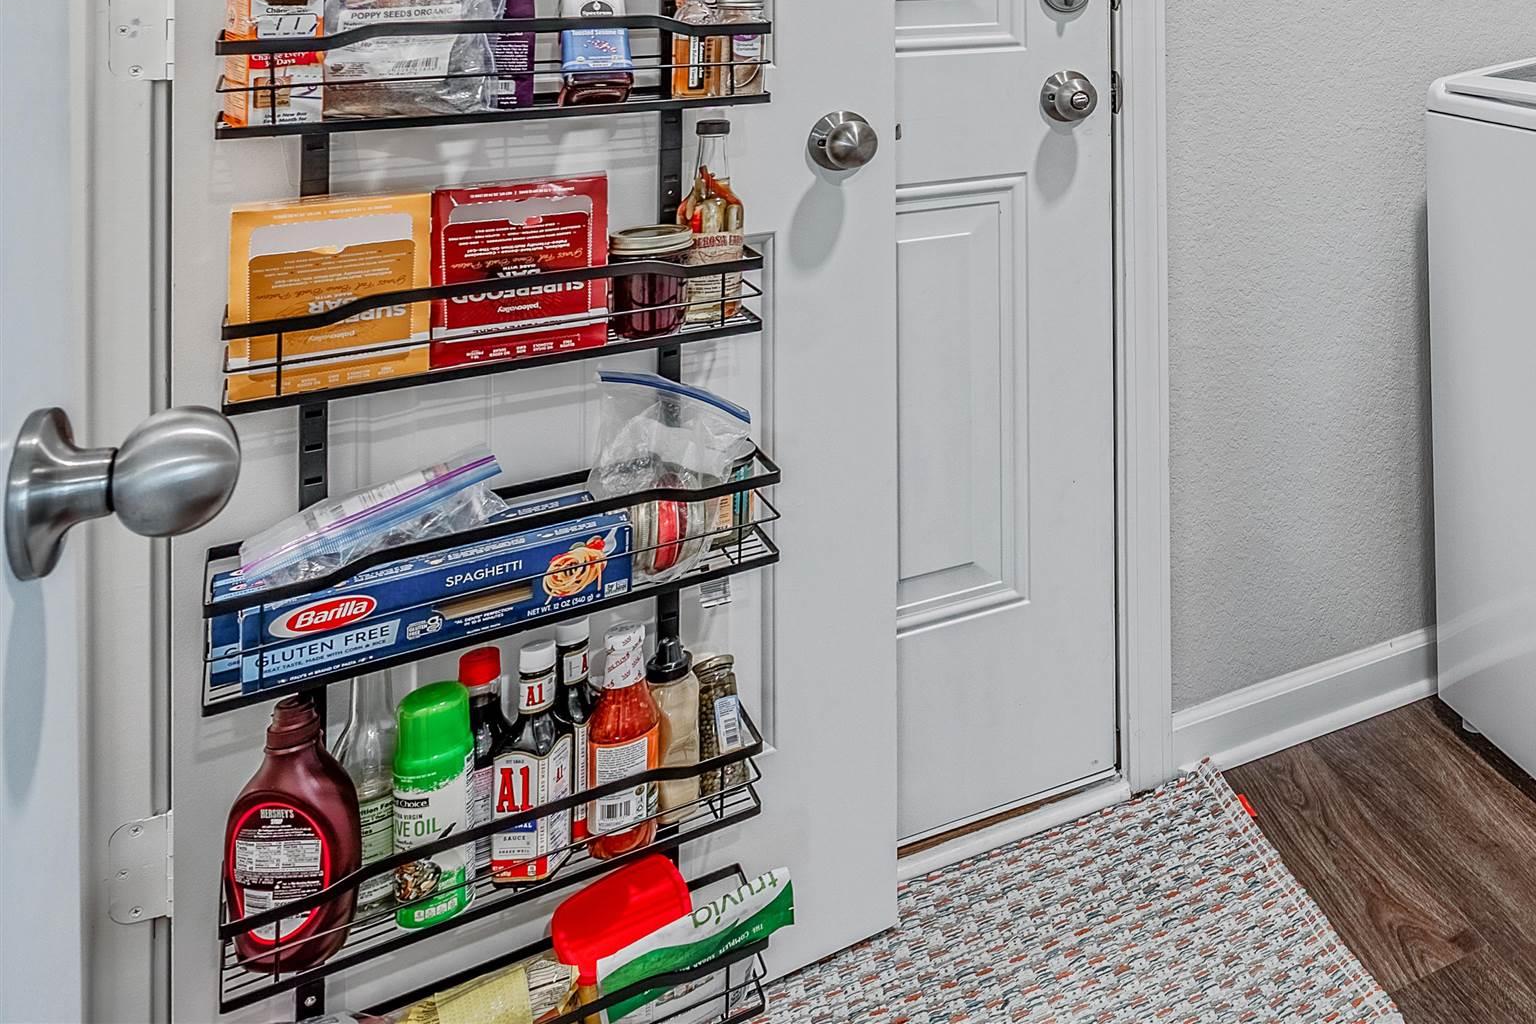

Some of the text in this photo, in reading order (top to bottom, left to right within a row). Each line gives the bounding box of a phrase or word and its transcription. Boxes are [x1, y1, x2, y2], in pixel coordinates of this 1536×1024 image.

[351, 6, 453, 20] POPPY SEEDS ORGANIC
[251, 53, 284, 64] Chage
[445, 560, 524, 588] SPAGHETTI
[294, 599, 369, 629] Barilla
[527, 607, 541, 617] NET
[560, 598, 571, 608] OZ
[255, 624, 391, 668] GLUTEN FREE
[305, 656, 325, 665] MADE
[326, 651, 343, 660] WITH
[344, 646, 364, 655] CORN
[371, 639, 387, 648] RICE
[526, 682, 546, 707] A1
[496, 765, 534, 813] A1
[399, 798, 428, 809] Choice
[403, 813, 423, 821] VIRGIN
[414, 817, 442, 837] OIL
